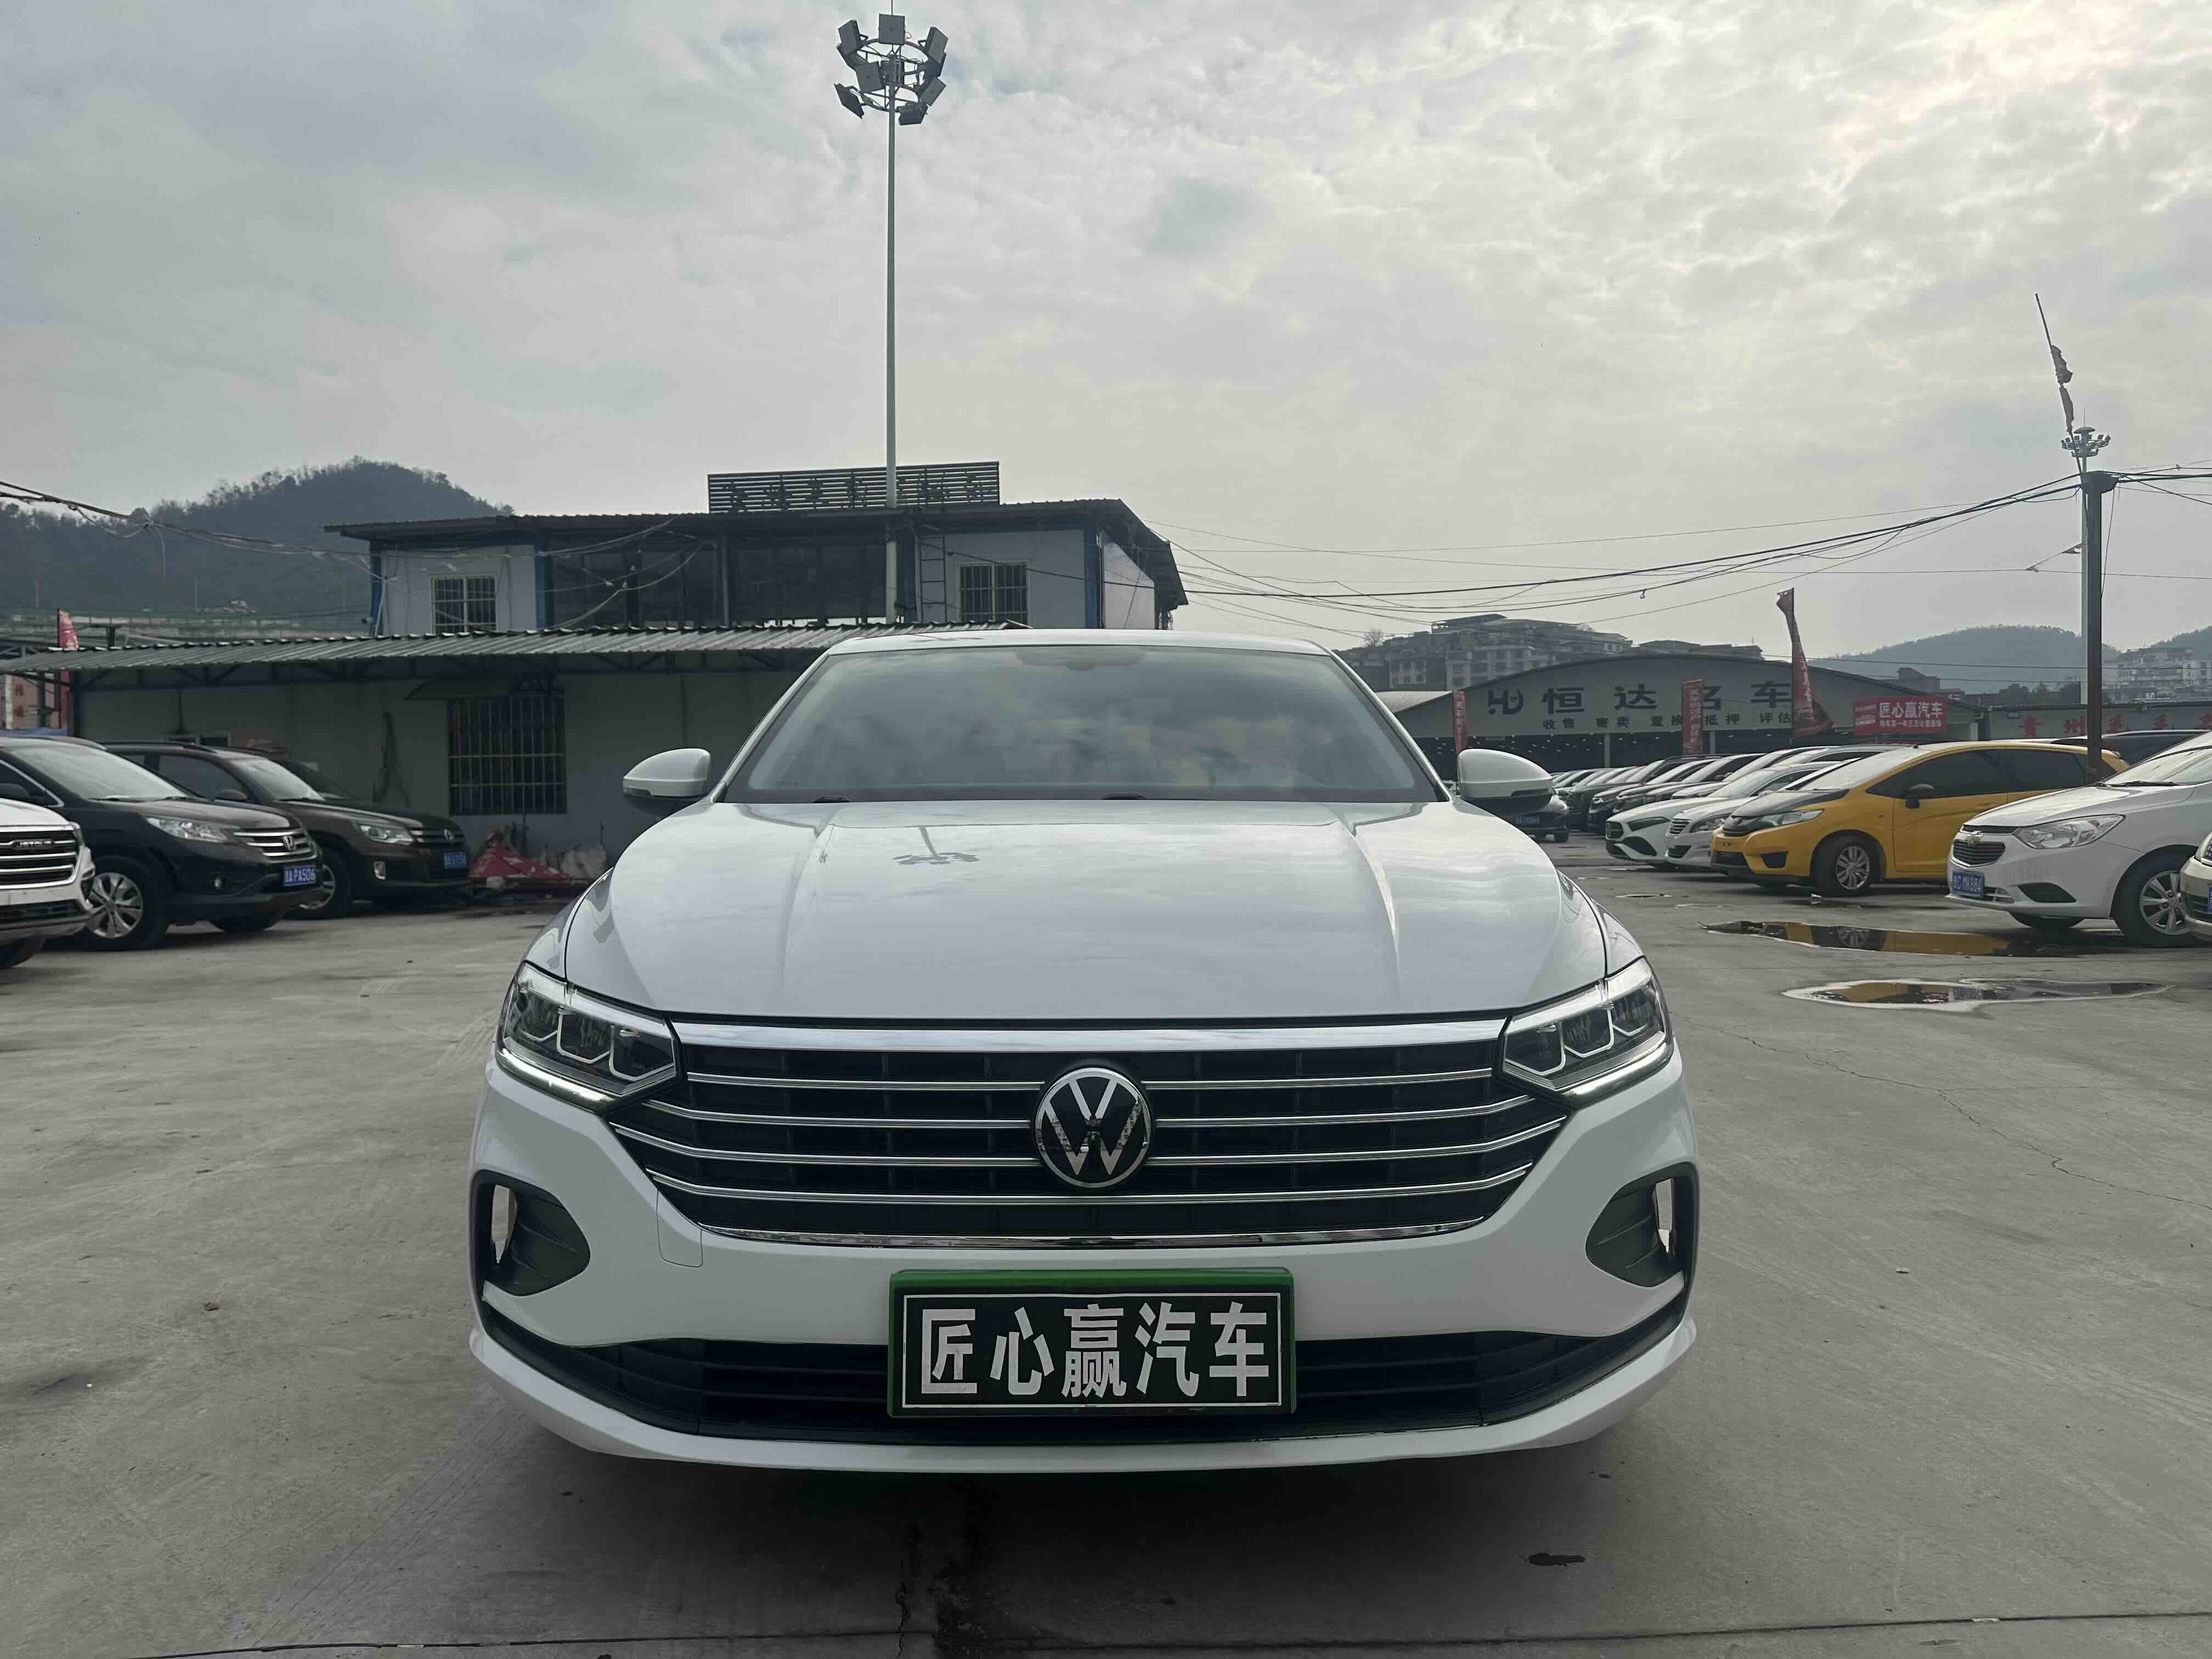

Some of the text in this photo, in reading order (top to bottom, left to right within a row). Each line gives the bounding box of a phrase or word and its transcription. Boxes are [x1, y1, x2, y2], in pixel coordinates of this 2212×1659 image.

[1879, 701, 1943, 719] 匠心赢汽车
[921, 1302, 1269, 1398] 匠心赢汽车
